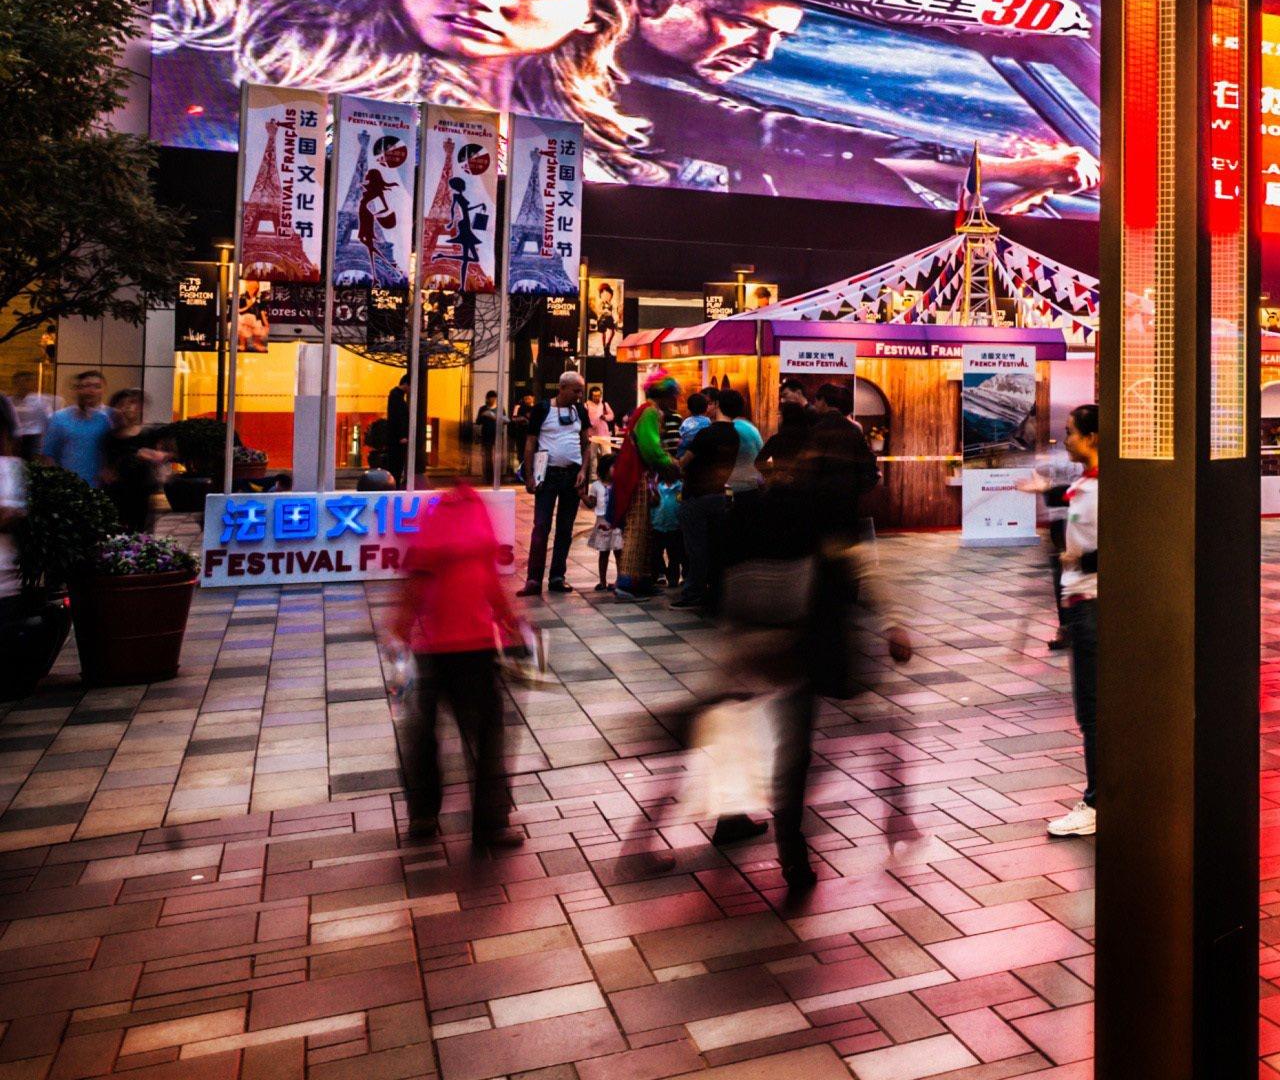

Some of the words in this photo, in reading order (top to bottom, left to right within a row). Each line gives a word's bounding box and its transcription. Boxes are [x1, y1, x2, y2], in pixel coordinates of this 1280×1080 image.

[348, 117, 377, 126] FESTIVAL
[434, 124, 462, 135] FESTIVAL
[296, 110, 318, 238] 法国文化节
[278, 177, 294, 238] FESTIVAL
[557, 140, 576, 257] 法国文化节
[541, 202, 555, 257] FESTIVAL
[269, 307, 297, 318] ores
[876, 343, 928, 356] FESTIVAL
[931, 344, 963, 357] FRAN
[787, 359, 814, 367] FRENCH
[816, 356, 848, 367] FESTIVAL
[969, 360, 996, 368] FRENCH
[998, 357, 1029, 368] FESTIVAL
[220, 495, 422, 544] 法国文化
[205, 549, 352, 578] FESTIVAL
